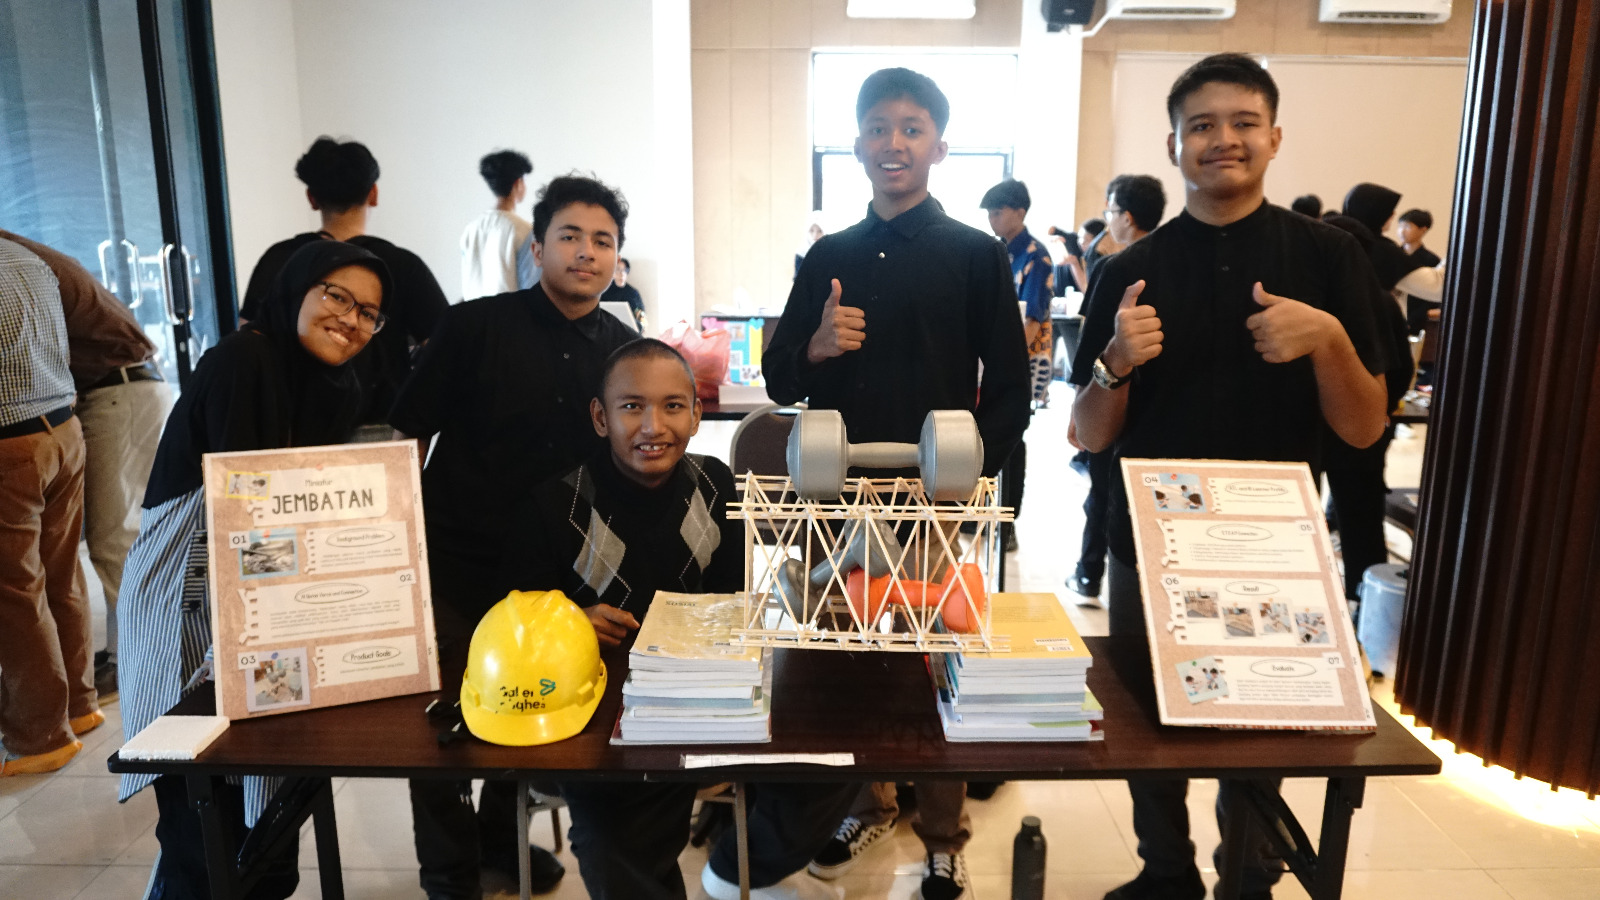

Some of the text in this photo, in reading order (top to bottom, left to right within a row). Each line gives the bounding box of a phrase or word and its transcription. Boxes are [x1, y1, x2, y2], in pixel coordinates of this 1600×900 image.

[1144, 476, 1158, 484] 04
[271, 488, 375, 515] JEMBATAN
[1300, 524, 1313, 532] 05
[232, 535, 247, 545] 01
[400, 573, 412, 583] 02
[1165, 577, 1180, 586] 06
[240, 655, 256, 665] 03
[1328, 656, 1340, 665] 07
